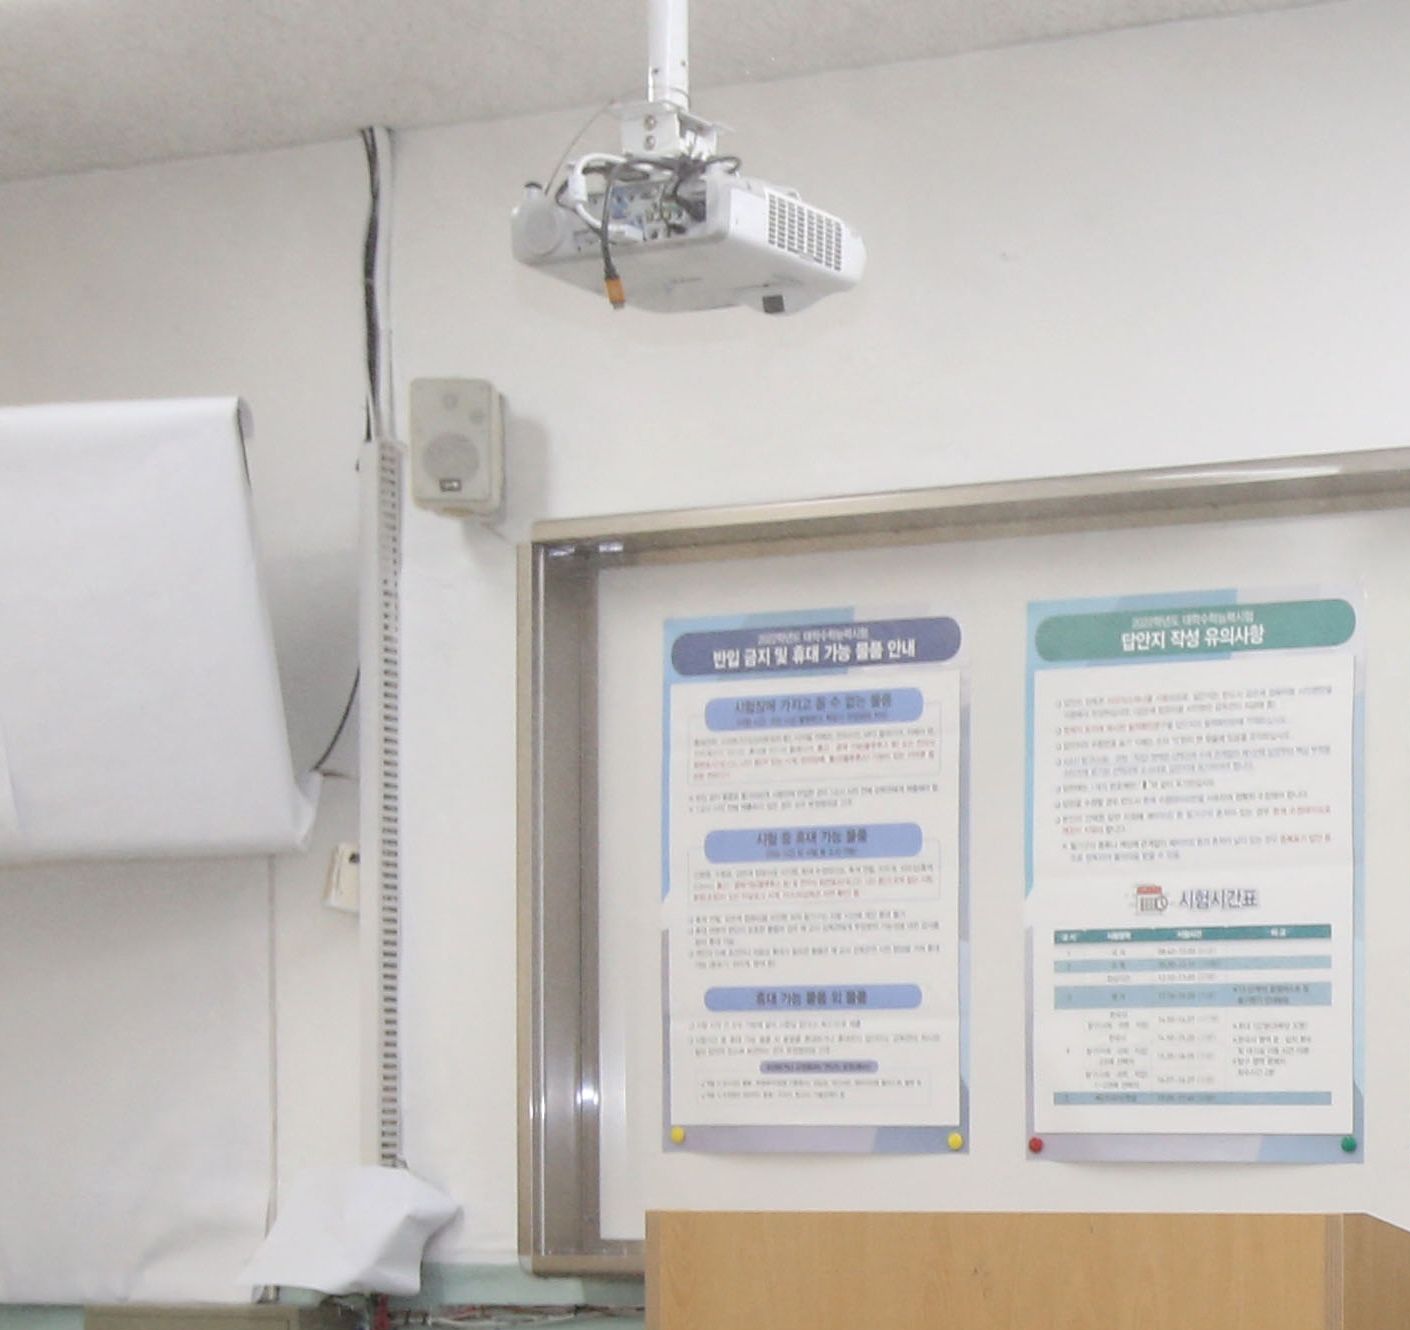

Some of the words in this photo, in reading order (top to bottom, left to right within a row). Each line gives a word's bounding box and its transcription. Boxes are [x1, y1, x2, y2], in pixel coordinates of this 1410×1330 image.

[1121, 630, 1165, 652] 답안지
[1170, 628, 1200, 649] 작성
[1204, 623, 1264, 648] 유의사항
[712, 648, 740, 670] 반입
[744, 646, 770, 668] 금지
[774, 645, 788, 666] 및
[792, 643, 819, 664] 휴대
[824, 642, 850, 663] 가능
[855, 640, 884, 661] 물품
[887, 638, 916, 659] 안내
[1179, 888, 1258, 910] 시험시간표
